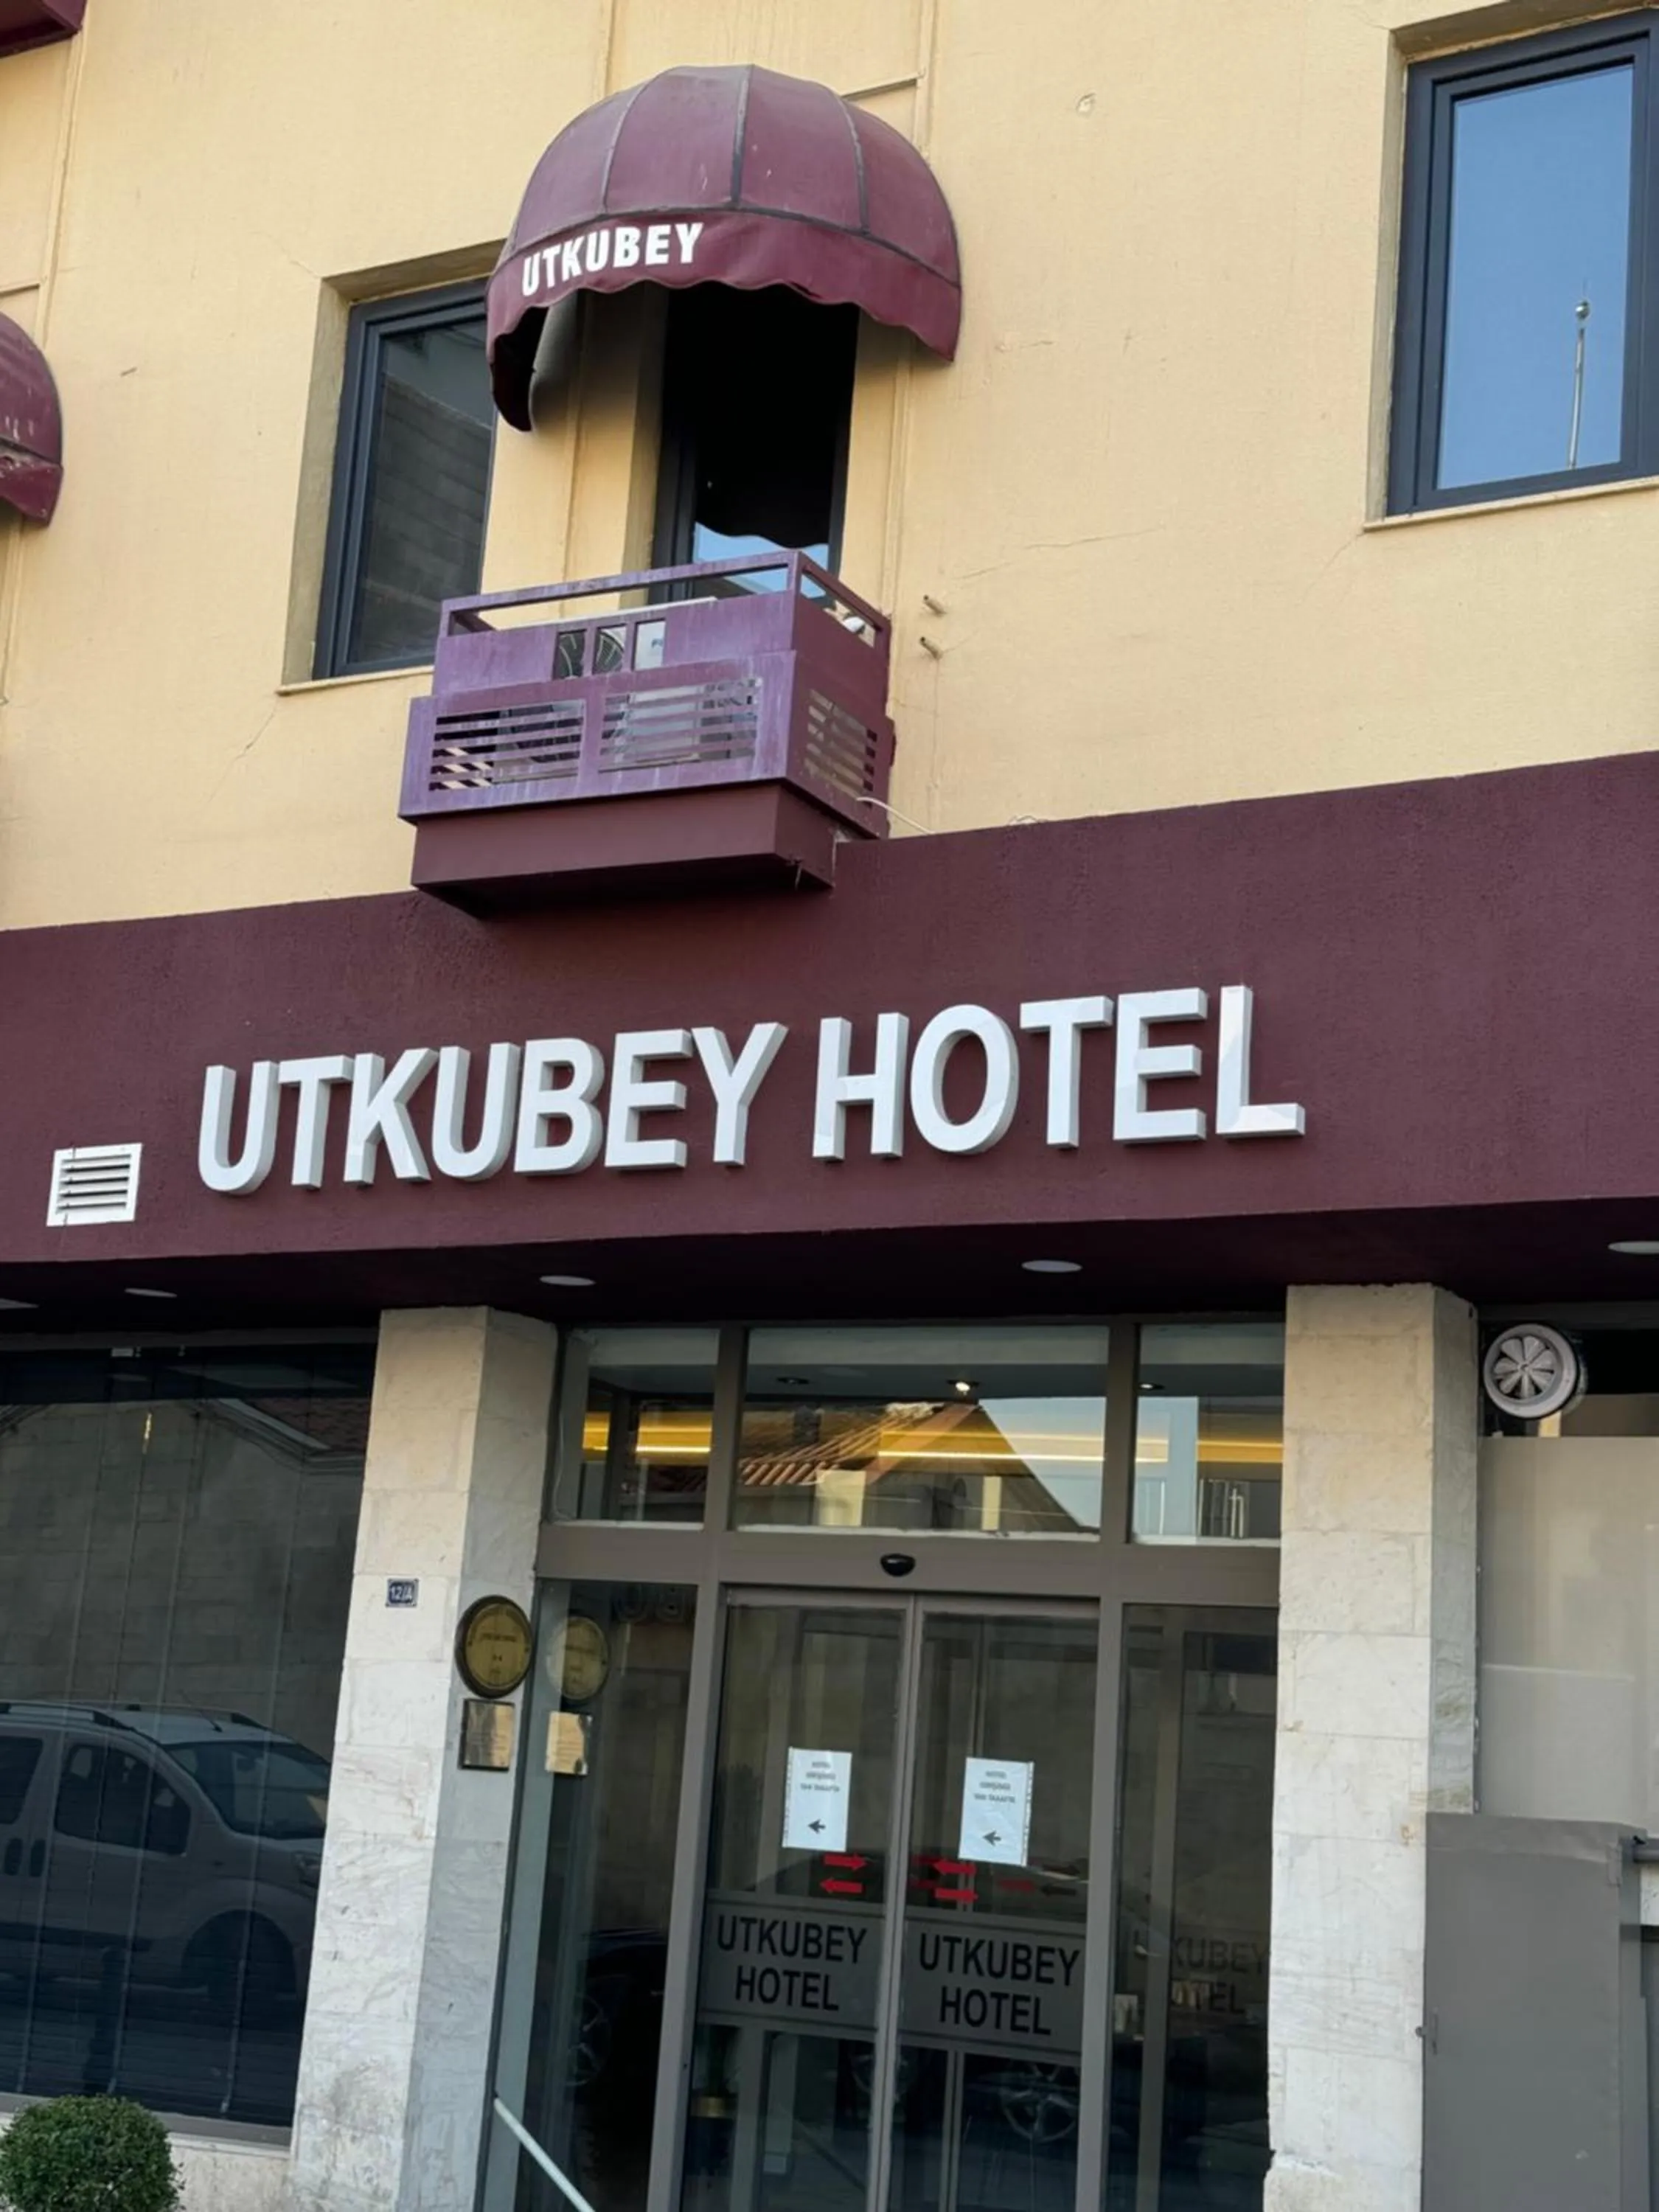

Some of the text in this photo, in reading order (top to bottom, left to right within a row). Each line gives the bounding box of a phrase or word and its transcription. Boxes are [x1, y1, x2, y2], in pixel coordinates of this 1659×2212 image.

[521, 222, 704, 297] UTKUBEY
[198, 984, 1307, 1196] UTKUBEY HOTEL
[717, 1914, 868, 1964] UTKUBEY
[919, 1933, 1081, 1986] UTKUBEY
[735, 1964, 840, 2011] HOTEL
[939, 1986, 1051, 2036] HOTEL
